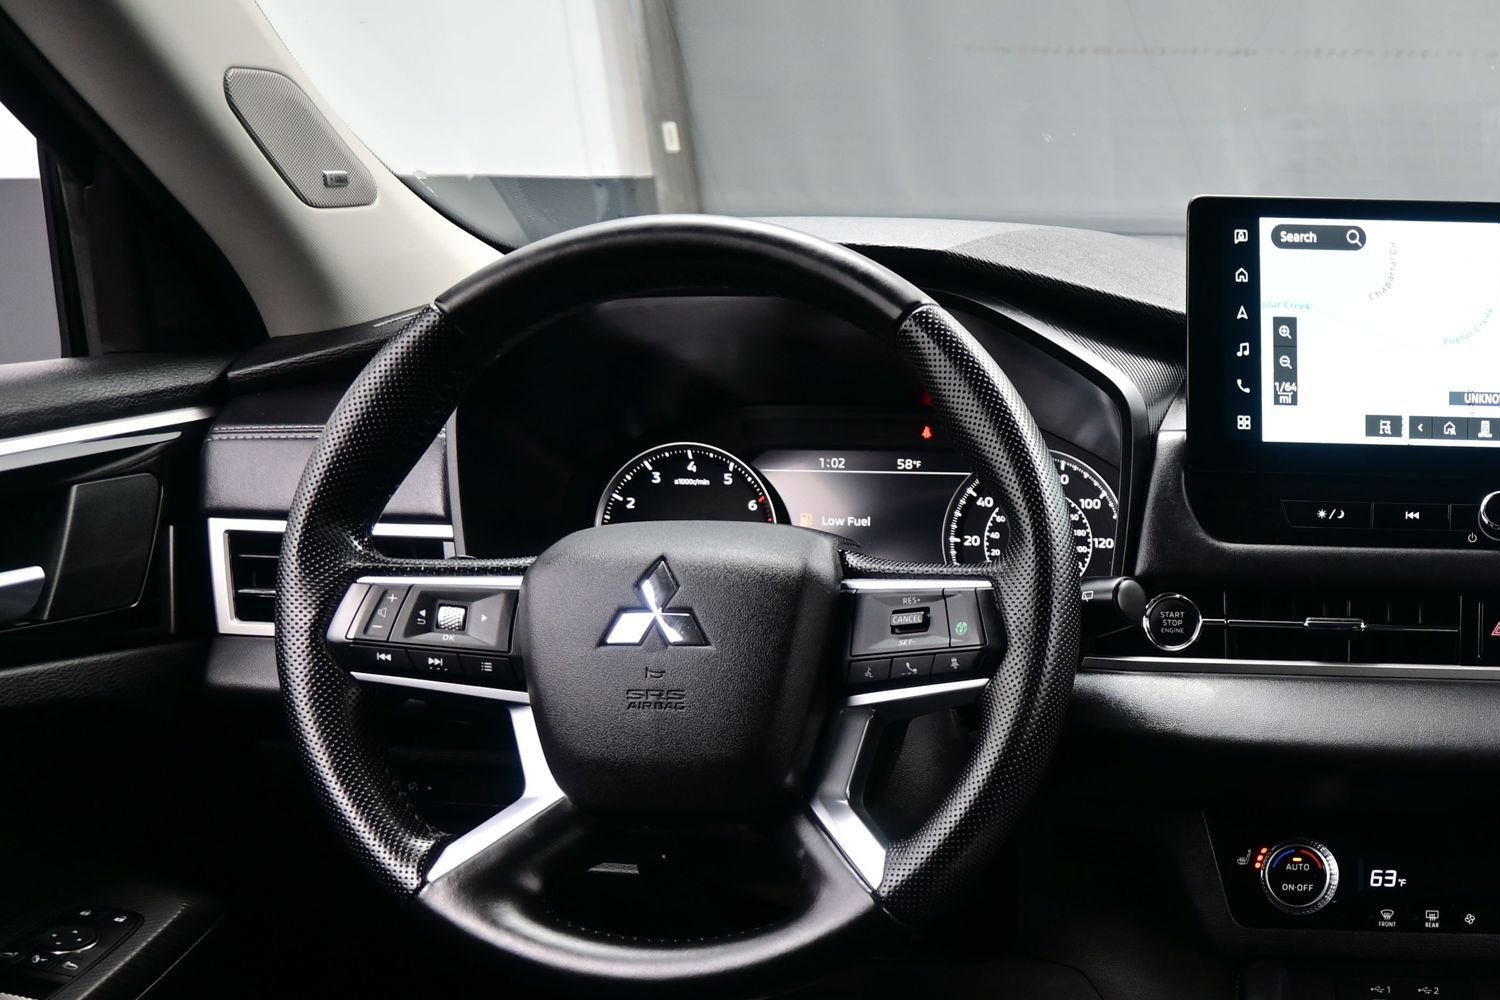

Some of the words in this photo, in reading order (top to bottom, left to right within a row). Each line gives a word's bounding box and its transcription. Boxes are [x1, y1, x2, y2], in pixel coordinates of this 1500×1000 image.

[1280, 231, 1317, 243] Search
[1274, 381, 1297, 392] 1/64
[686, 461, 697, 472] 4
[819, 457, 846, 469] 1:02
[651, 471, 661, 484] 3
[723, 473, 733, 485] 5
[626, 497, 636, 509] 2
[748, 500, 758, 511] 6
[976, 496, 994, 508] 40
[1079, 498, 1101, 510] 100
[822, 516, 845, 527] Low
[847, 515, 871, 527] Fuel
[995, 515, 1006, 523] 60
[963, 535, 981, 546] 20
[989, 531, 1000, 539] 40
[1093, 537, 1114, 549] 120
[990, 548, 1001, 556] 20
[902, 597, 921, 605] RES+
[892, 614, 922, 624] CANCEL
[442, 633, 455, 641] OK
[626, 688, 686, 701] SRS
[626, 701, 686, 711] AIRBAG
[1286, 863, 1310, 871] AUTO
[1378, 920, 1397, 928] FRONT
[1386, 986, 1391, 994] 1
[1433, 987, 1439, 995] 2
